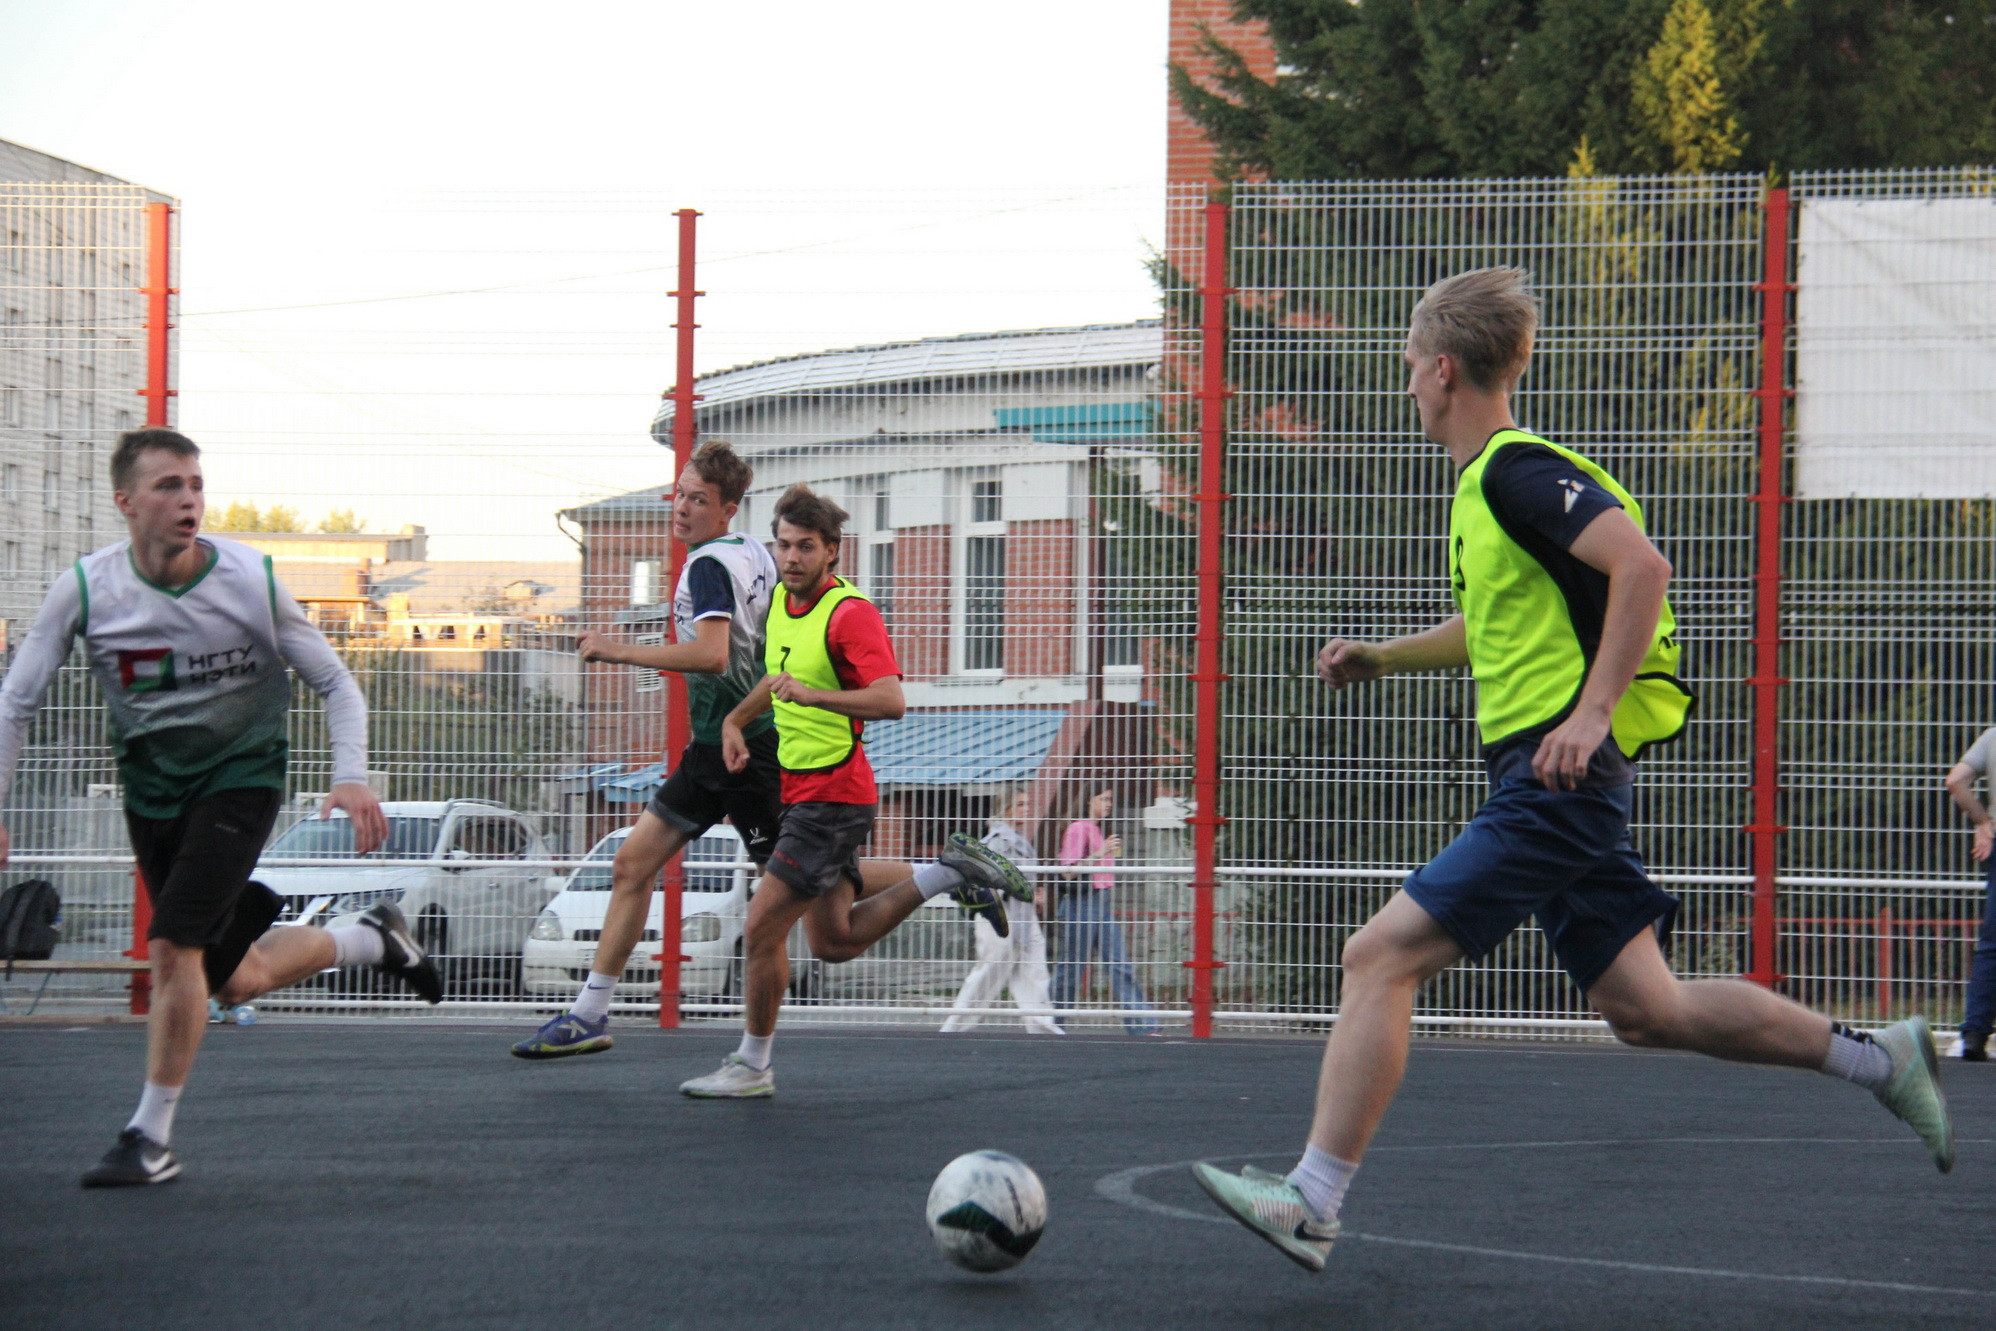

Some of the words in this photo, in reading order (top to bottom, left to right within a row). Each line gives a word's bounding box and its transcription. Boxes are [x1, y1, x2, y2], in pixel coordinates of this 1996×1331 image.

[188, 644, 254, 669] НГТУ
[780, 645, 791, 672] 7
[189, 661, 256, 684] НЭТИ
